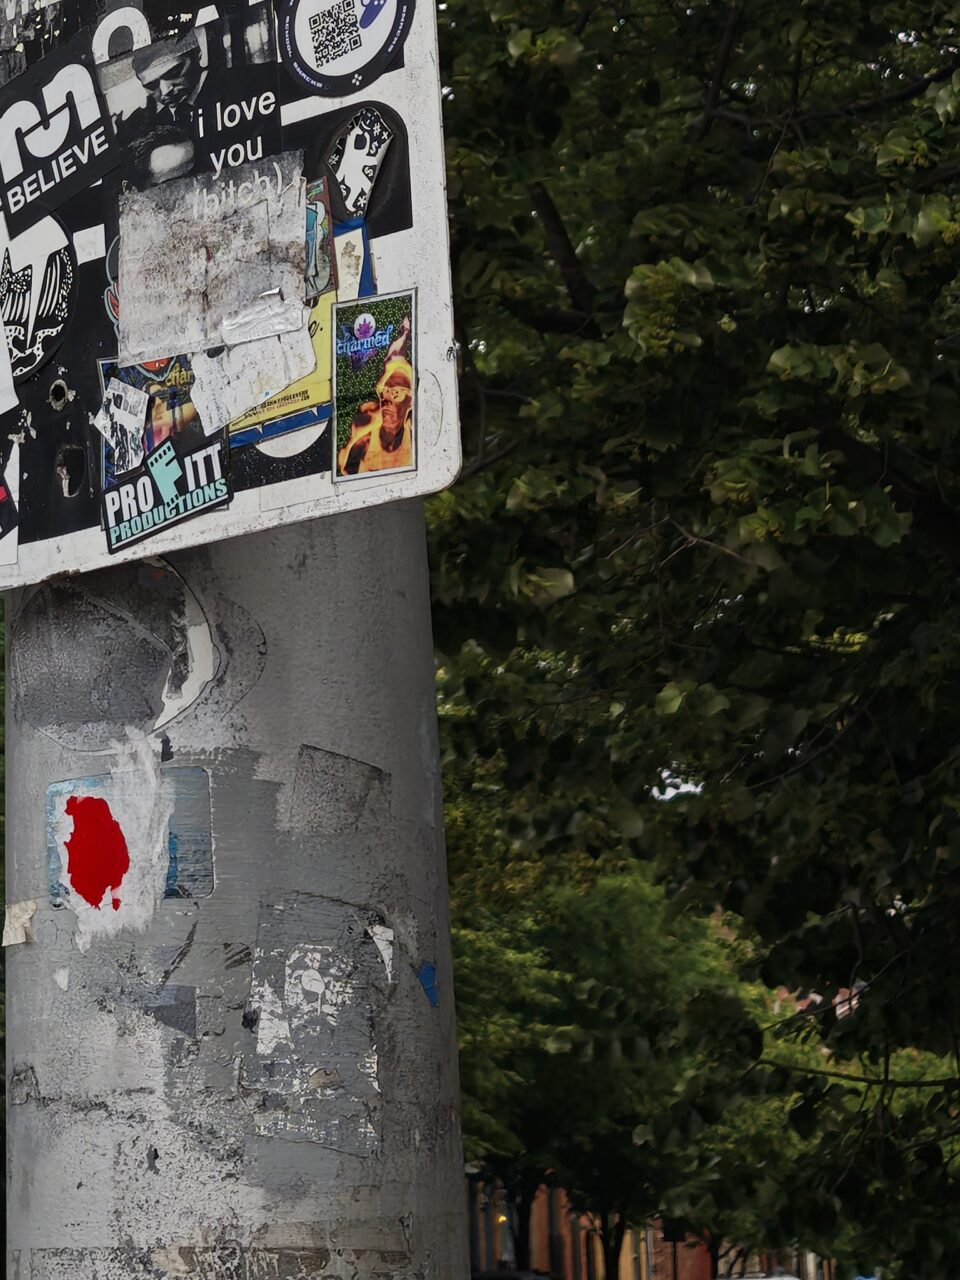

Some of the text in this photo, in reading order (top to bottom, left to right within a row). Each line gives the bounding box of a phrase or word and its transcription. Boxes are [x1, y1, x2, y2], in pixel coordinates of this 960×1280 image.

[198, 91, 276, 138] i love
[6, 126, 109, 214] BELIEVE
[210, 136, 263, 180] you
[109, 477, 228, 545] PRODUCTIONS
